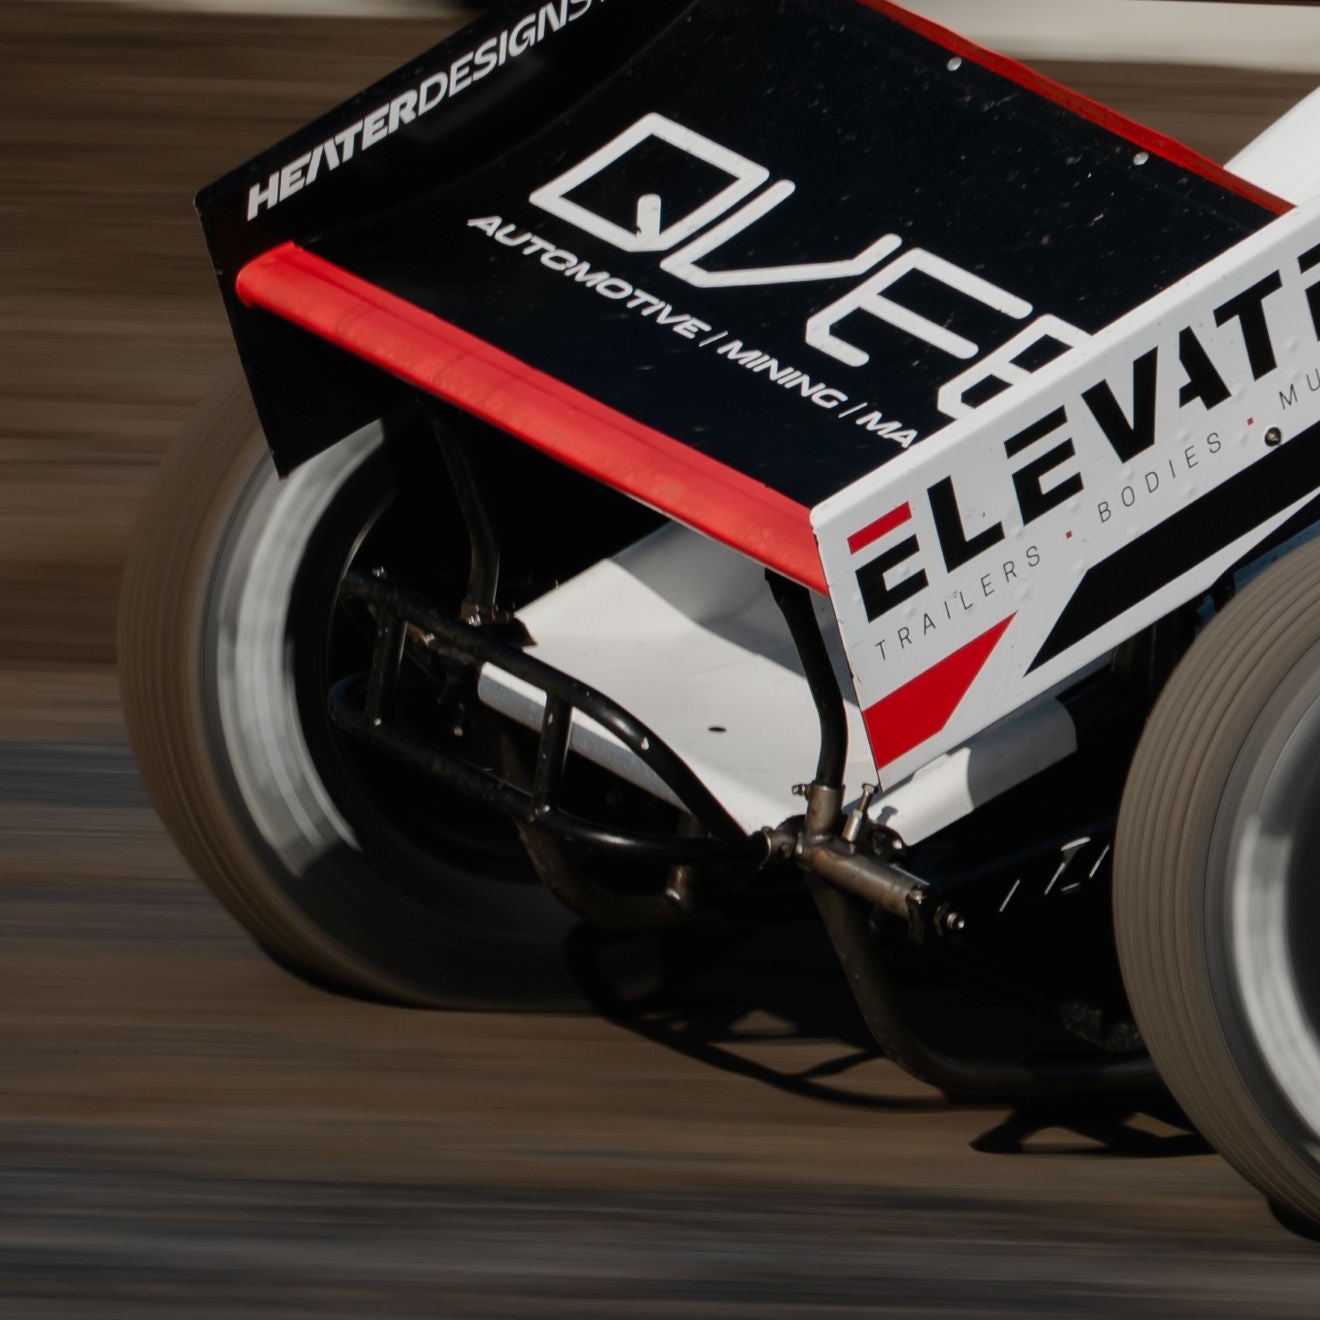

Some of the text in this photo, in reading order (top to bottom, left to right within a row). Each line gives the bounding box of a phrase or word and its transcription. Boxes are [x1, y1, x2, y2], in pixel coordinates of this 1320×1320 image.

[467, 215, 849, 412] AUTOMOTIVE MINING
[875, 545, 1042, 663] TRAILERS
[1098, 431, 1223, 525] BODIES
